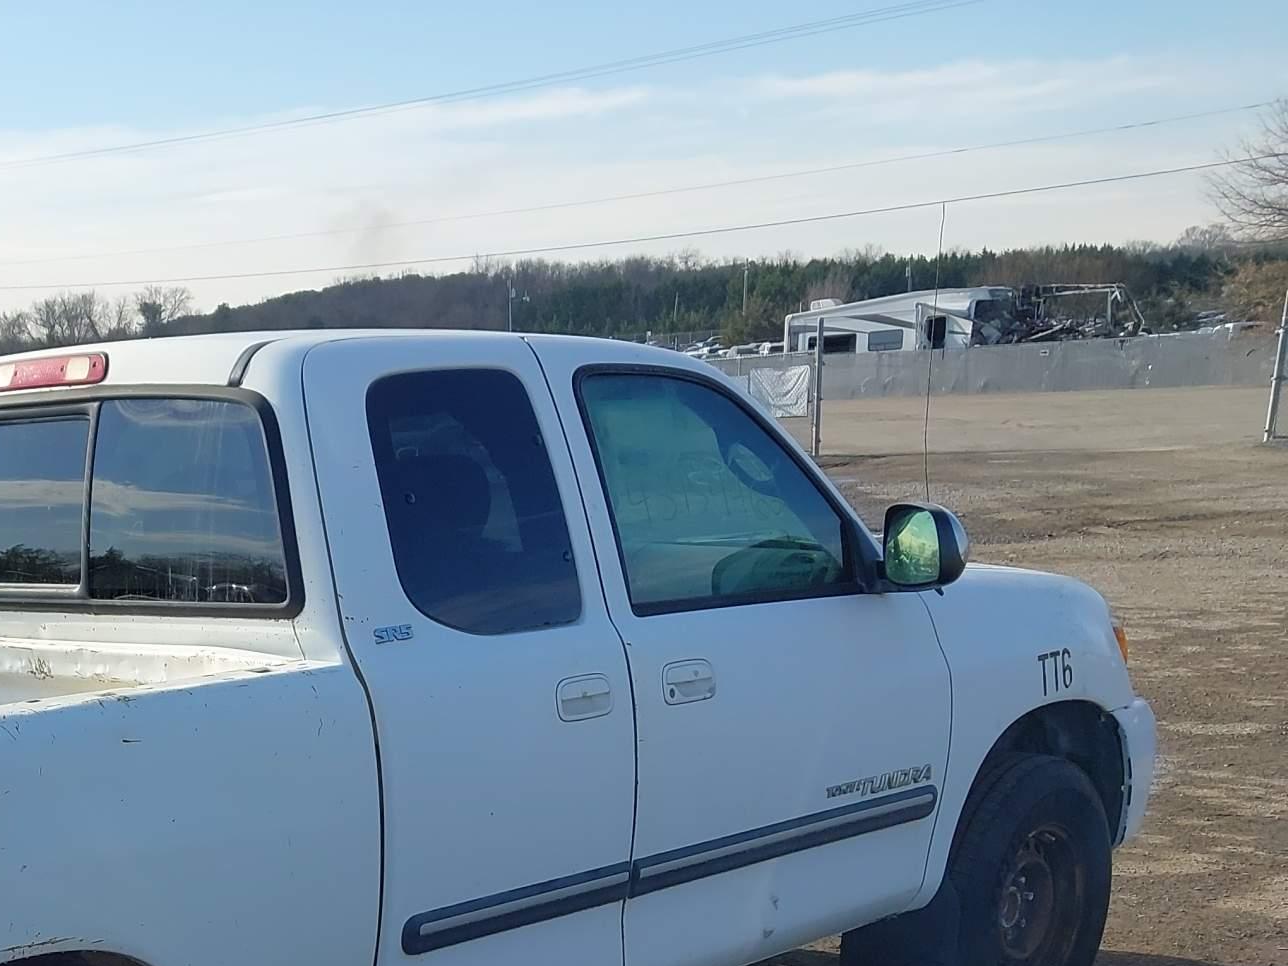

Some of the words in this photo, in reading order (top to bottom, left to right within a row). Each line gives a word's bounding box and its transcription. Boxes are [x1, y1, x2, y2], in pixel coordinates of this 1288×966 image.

[373, 624, 413, 645] SR5
[1037, 647, 1073, 697] TT6
[860, 764, 931, 796] TUNDRA
